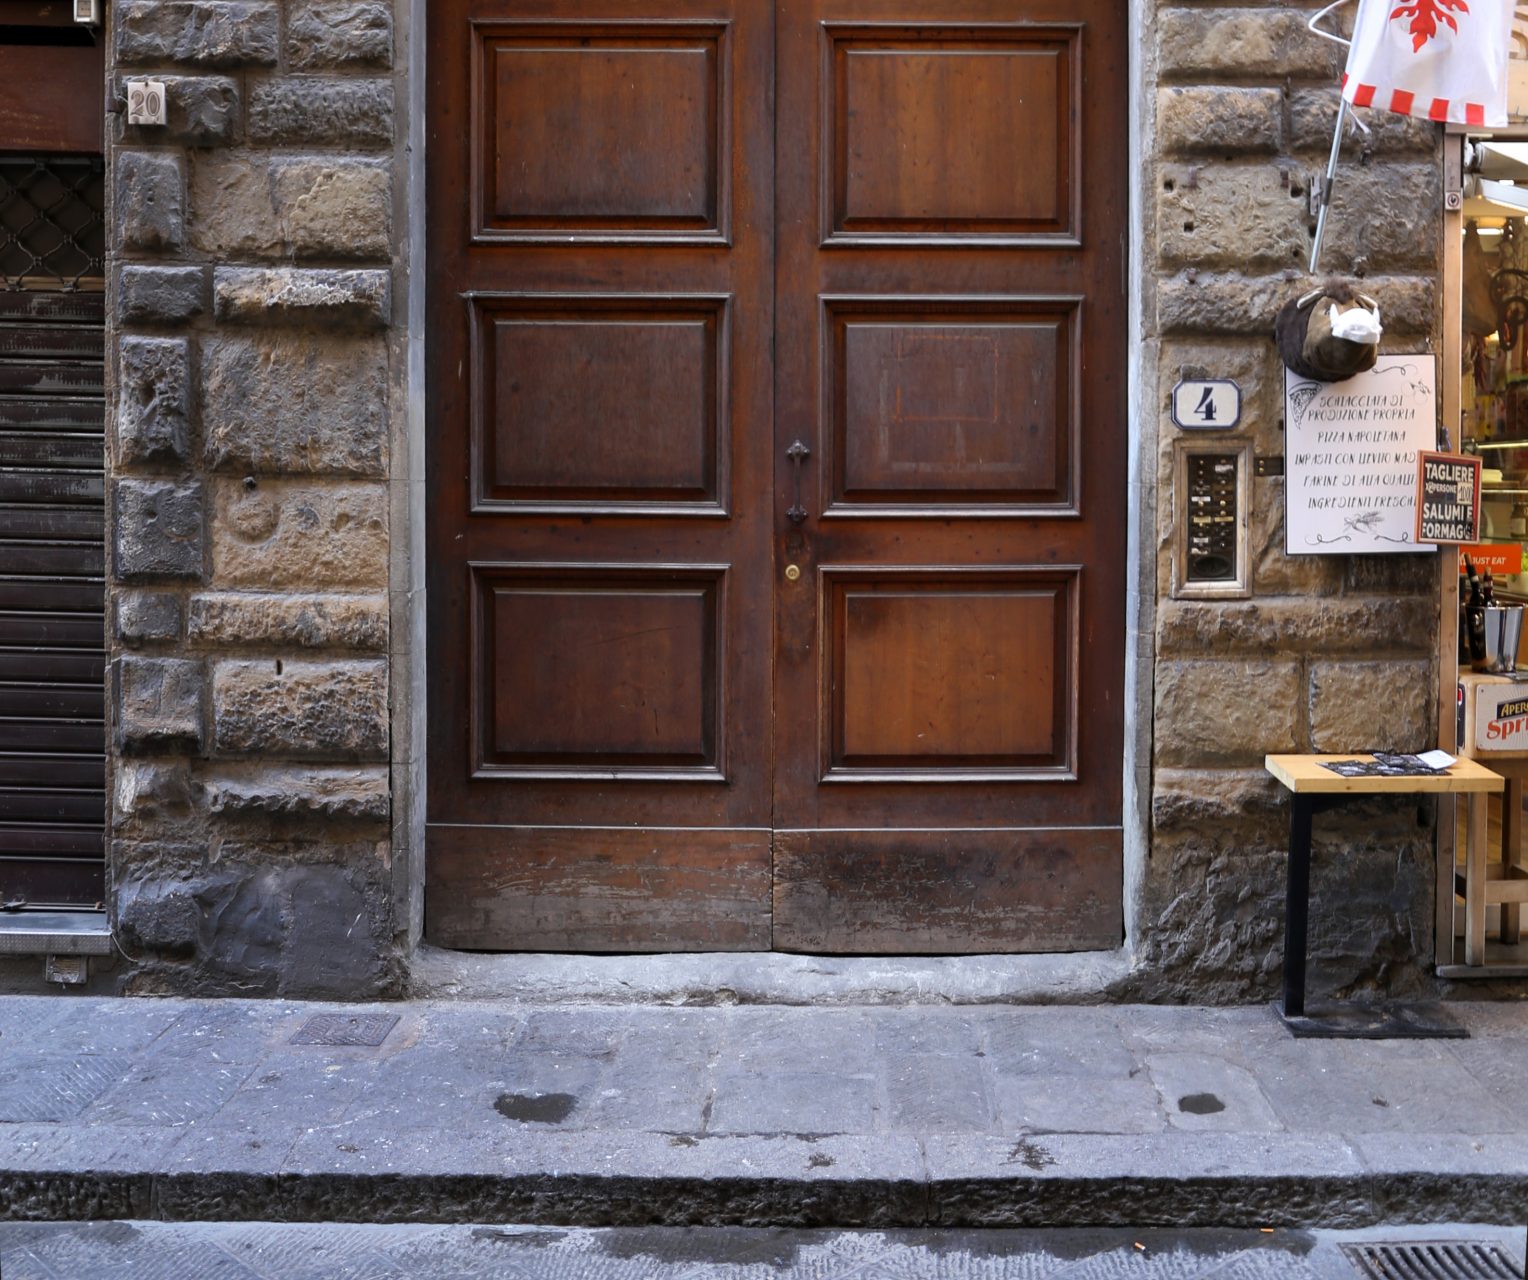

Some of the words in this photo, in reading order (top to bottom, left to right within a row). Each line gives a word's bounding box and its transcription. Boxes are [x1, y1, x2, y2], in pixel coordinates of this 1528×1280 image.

[130, 89, 161, 117] 20
[1193, 386, 1217, 421] 4
[1390, 395, 1404, 407] DI
[1308, 408, 1370, 421] PRODUZIONE
[1373, 408, 1415, 420] PROPRIA
[1317, 431, 1345, 443] PIZZA
[1348, 431, 1406, 443] NAPOLETANA
[1294, 453, 1333, 466] IMPASTI
[1334, 453, 1355, 465] CON
[1358, 452, 1392, 465] LIEVITO
[1425, 463, 1474, 482] TAGLIERE
[1303, 475, 1338, 487] FARINE
[1342, 475, 1356, 487] DI
[1360, 474, 1380, 487] ALTA
[1382, 474, 1417, 487] QUALIT
[1308, 497, 1371, 510] INGREDIENTI
[1423, 503, 1465, 521] SALUMI
[1472, 556, 1491, 565] JUST
[1491, 556, 1507, 565] EAT
[1501, 701, 1528, 717] APER
